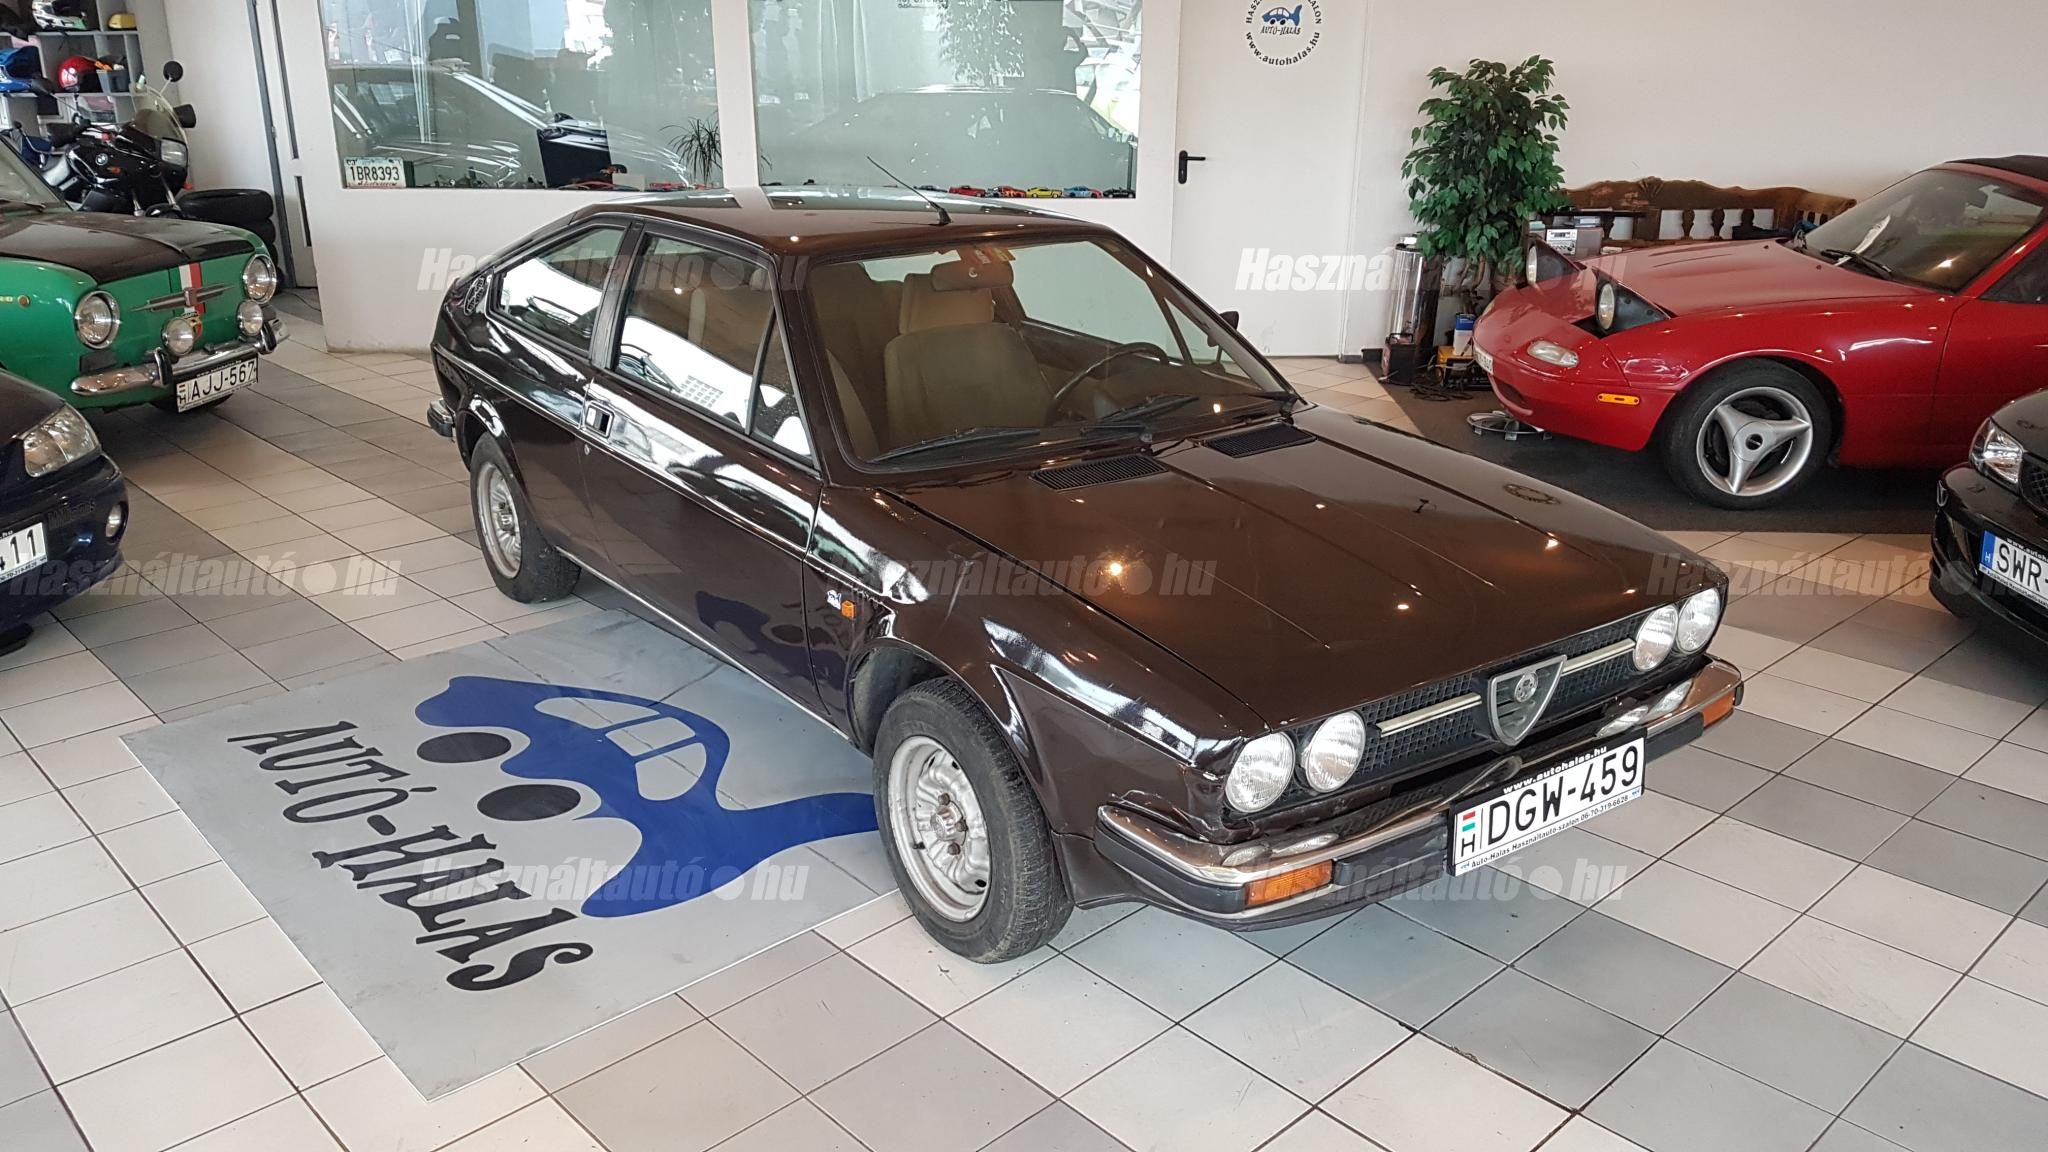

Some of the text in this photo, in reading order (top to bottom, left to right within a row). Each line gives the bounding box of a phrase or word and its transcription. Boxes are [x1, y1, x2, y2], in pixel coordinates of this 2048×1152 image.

[1245, 31, 1320, 66] www.autohalas.hu
[350, 166, 400, 182] 1BR8393
[191, 361, 255, 401] AJJ-567
[1984, 551, 1991, 563] H
[1503, 746, 1607, 794] www.autohalas.hu
[1460, 745, 1638, 858] H DGW-459
